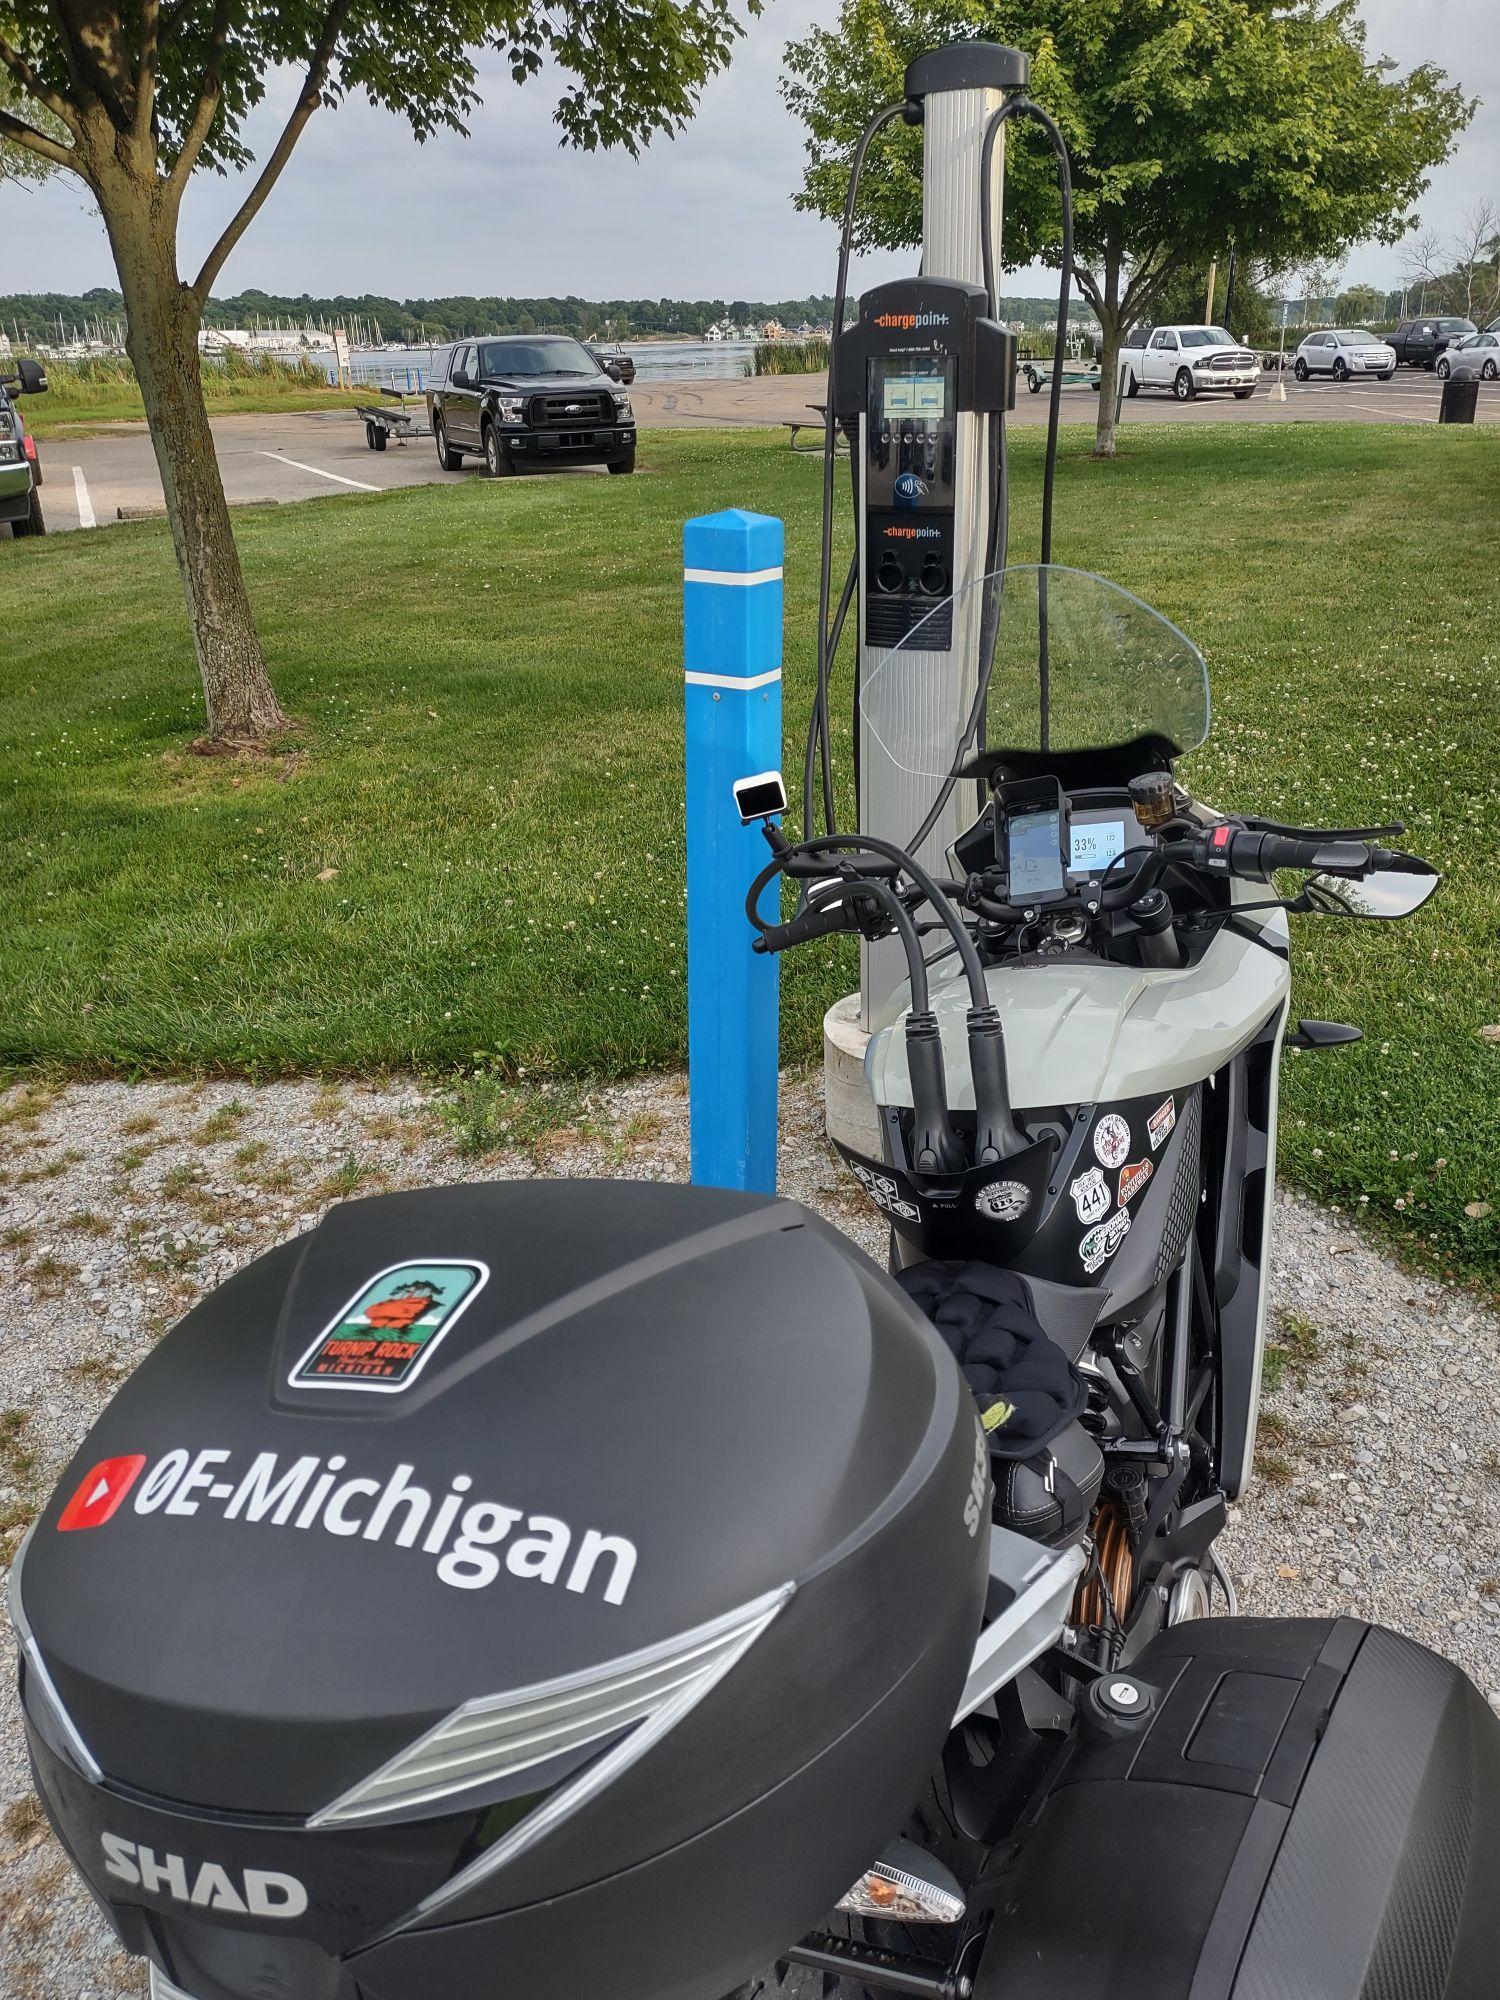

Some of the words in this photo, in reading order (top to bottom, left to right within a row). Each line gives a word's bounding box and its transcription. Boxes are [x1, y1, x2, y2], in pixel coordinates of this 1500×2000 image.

[1074, 838, 1096, 851] 33%
[1083, 1183, 1106, 1212] 441
[321, 1340, 377, 1356] TURNIP
[374, 1342, 420, 1358] ROCK
[316, 1363, 394, 1376] MICHIGAN
[101, 1832, 308, 1918] SHAD
